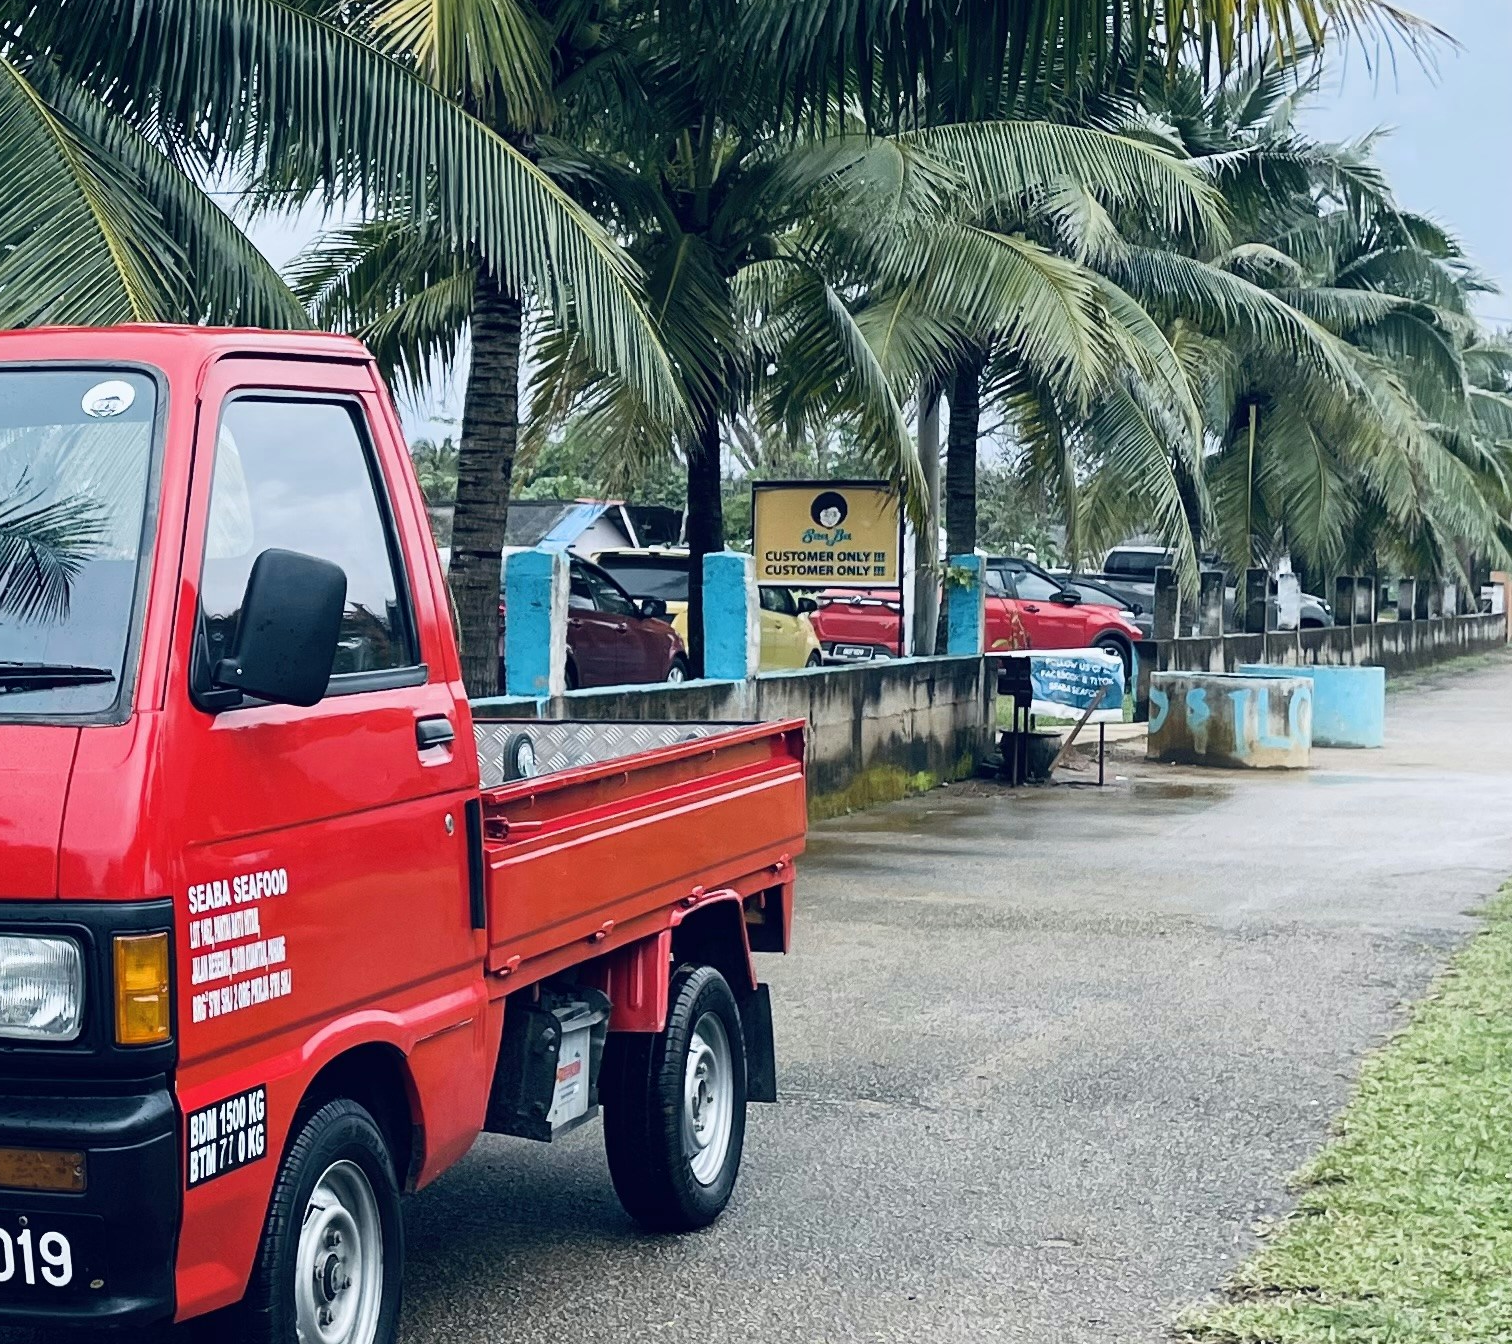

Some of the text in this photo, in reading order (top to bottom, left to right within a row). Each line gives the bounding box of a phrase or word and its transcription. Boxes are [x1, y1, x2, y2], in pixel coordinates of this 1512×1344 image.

[765, 551, 833, 562] CUSTOMER
[836, 551, 871, 562] ONLY
[765, 565, 833, 576] CUSTOMER
[836, 565, 871, 576] ONLY
[1045, 658, 1078, 669] FOLLOW
[1079, 662, 1091, 672] US
[188, 868, 288, 914] SEABA SEAFOOD
[190, 1089, 264, 1149] BDM 1500 KG
[190, 1142, 217, 1183] BTM
[248, 1123, 264, 1159] KG
